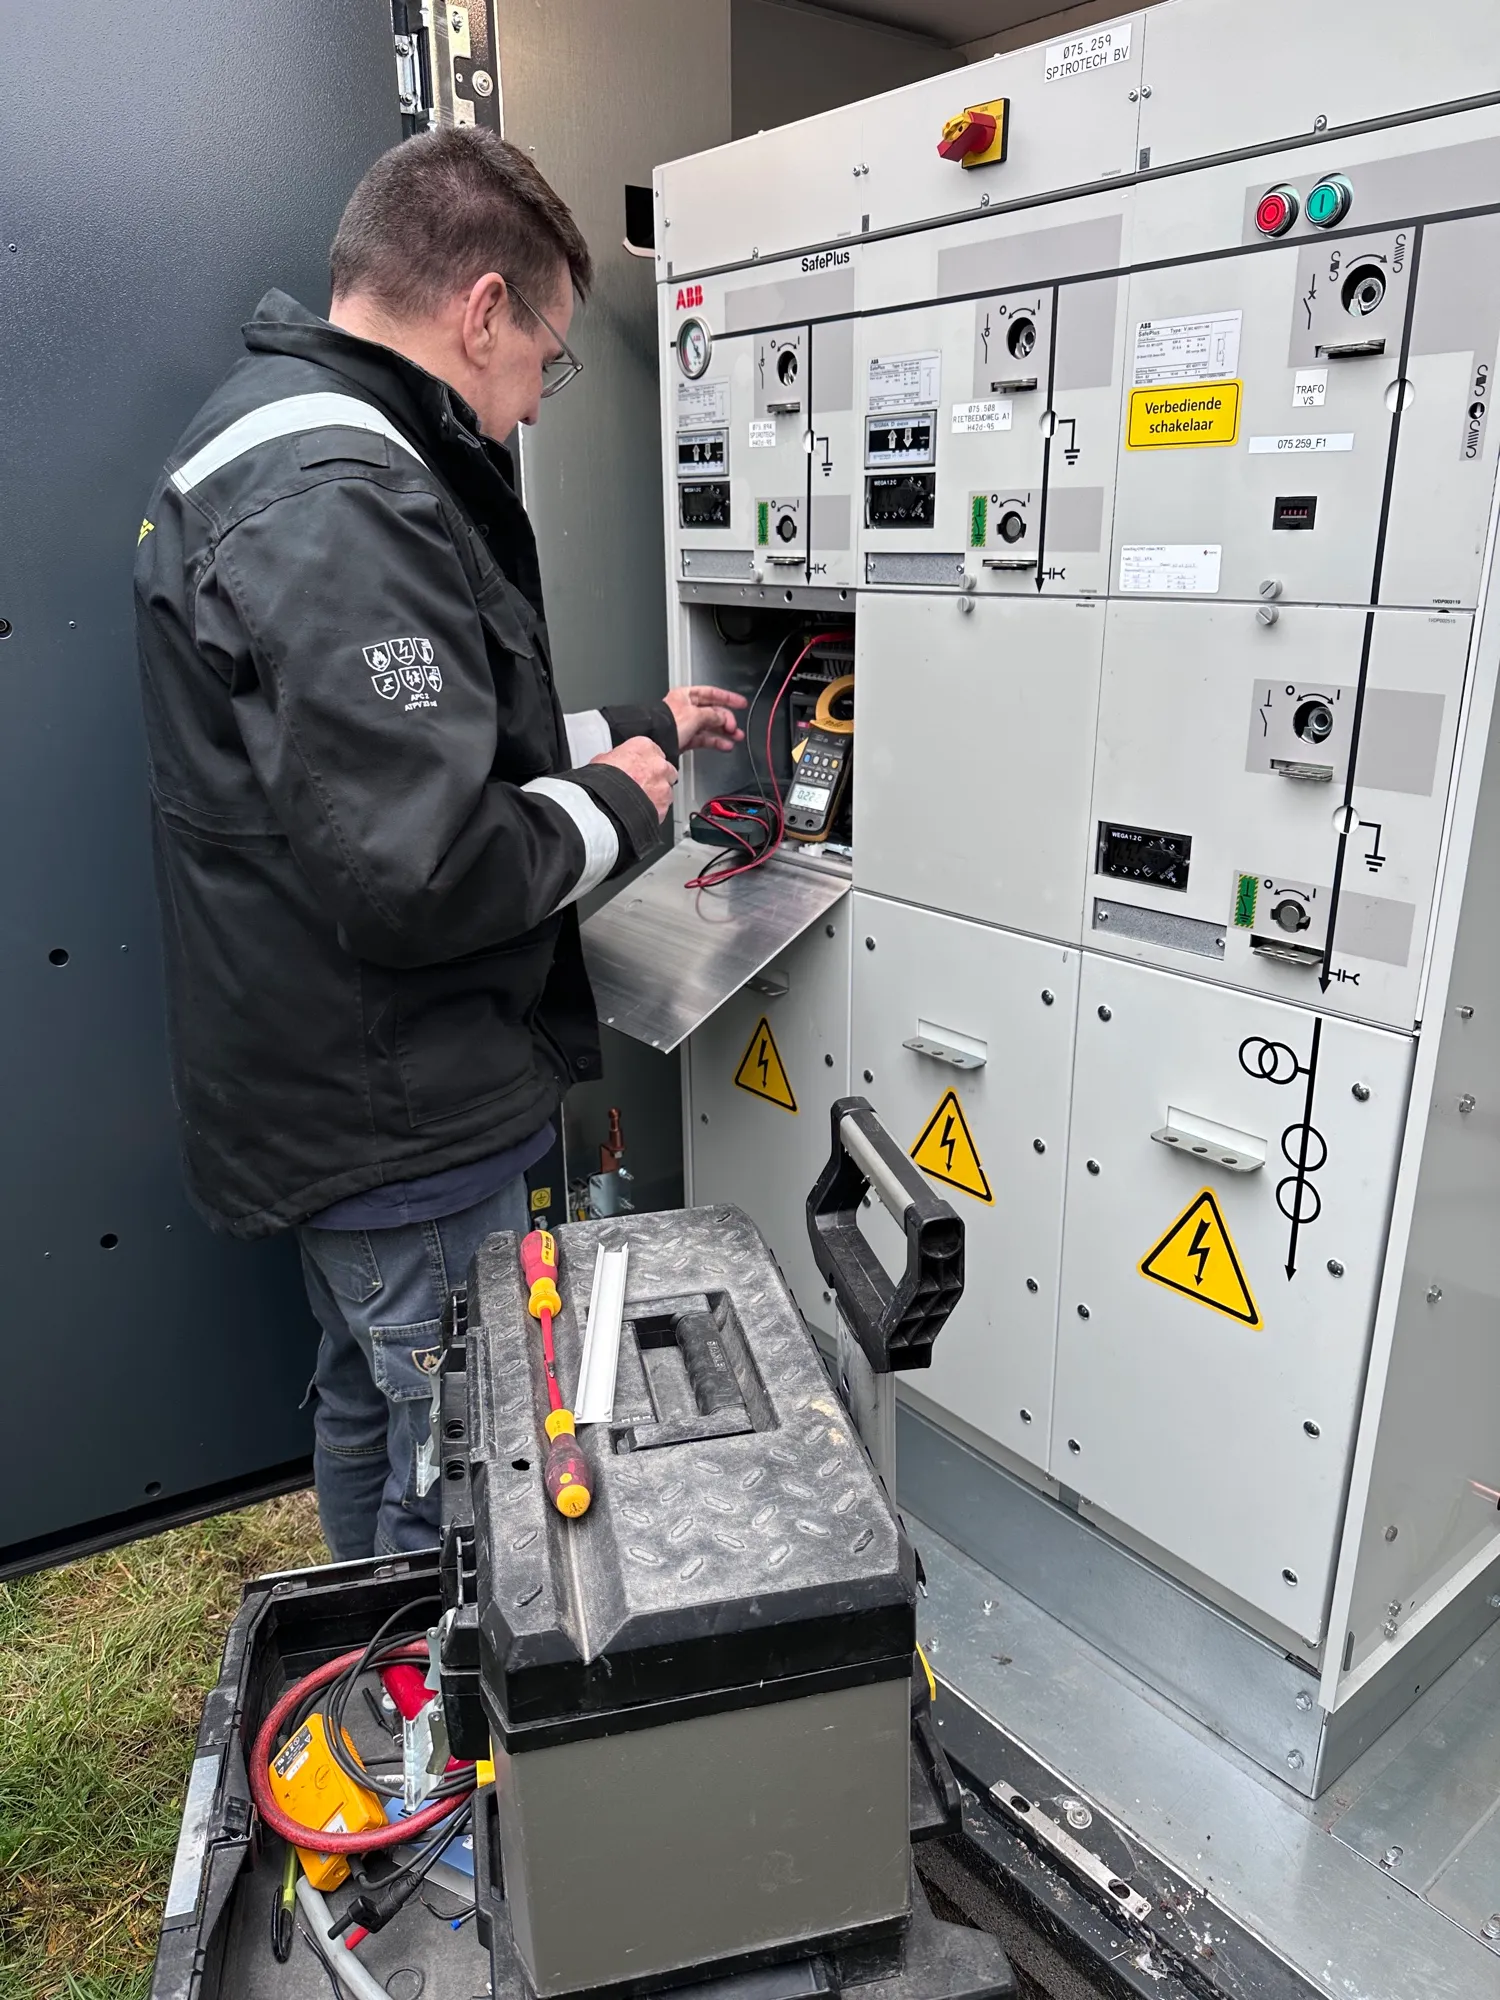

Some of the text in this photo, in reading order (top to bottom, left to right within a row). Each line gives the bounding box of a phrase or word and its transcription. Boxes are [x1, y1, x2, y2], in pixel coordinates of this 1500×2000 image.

[1046, 46, 1129, 80] SPIROTECH BV
[801, 251, 850, 272] SafePlus
[676, 285, 703, 310] ABB
[1296, 384, 1325, 394] TRAFO
[1145, 397, 1222, 414] Verbediende
[1303, 396, 1314, 405] VS
[1002, 412, 1010, 420] A1
[1149, 418, 1214, 434] schakelaar
[1111, 831, 1128, 840] WEGA
